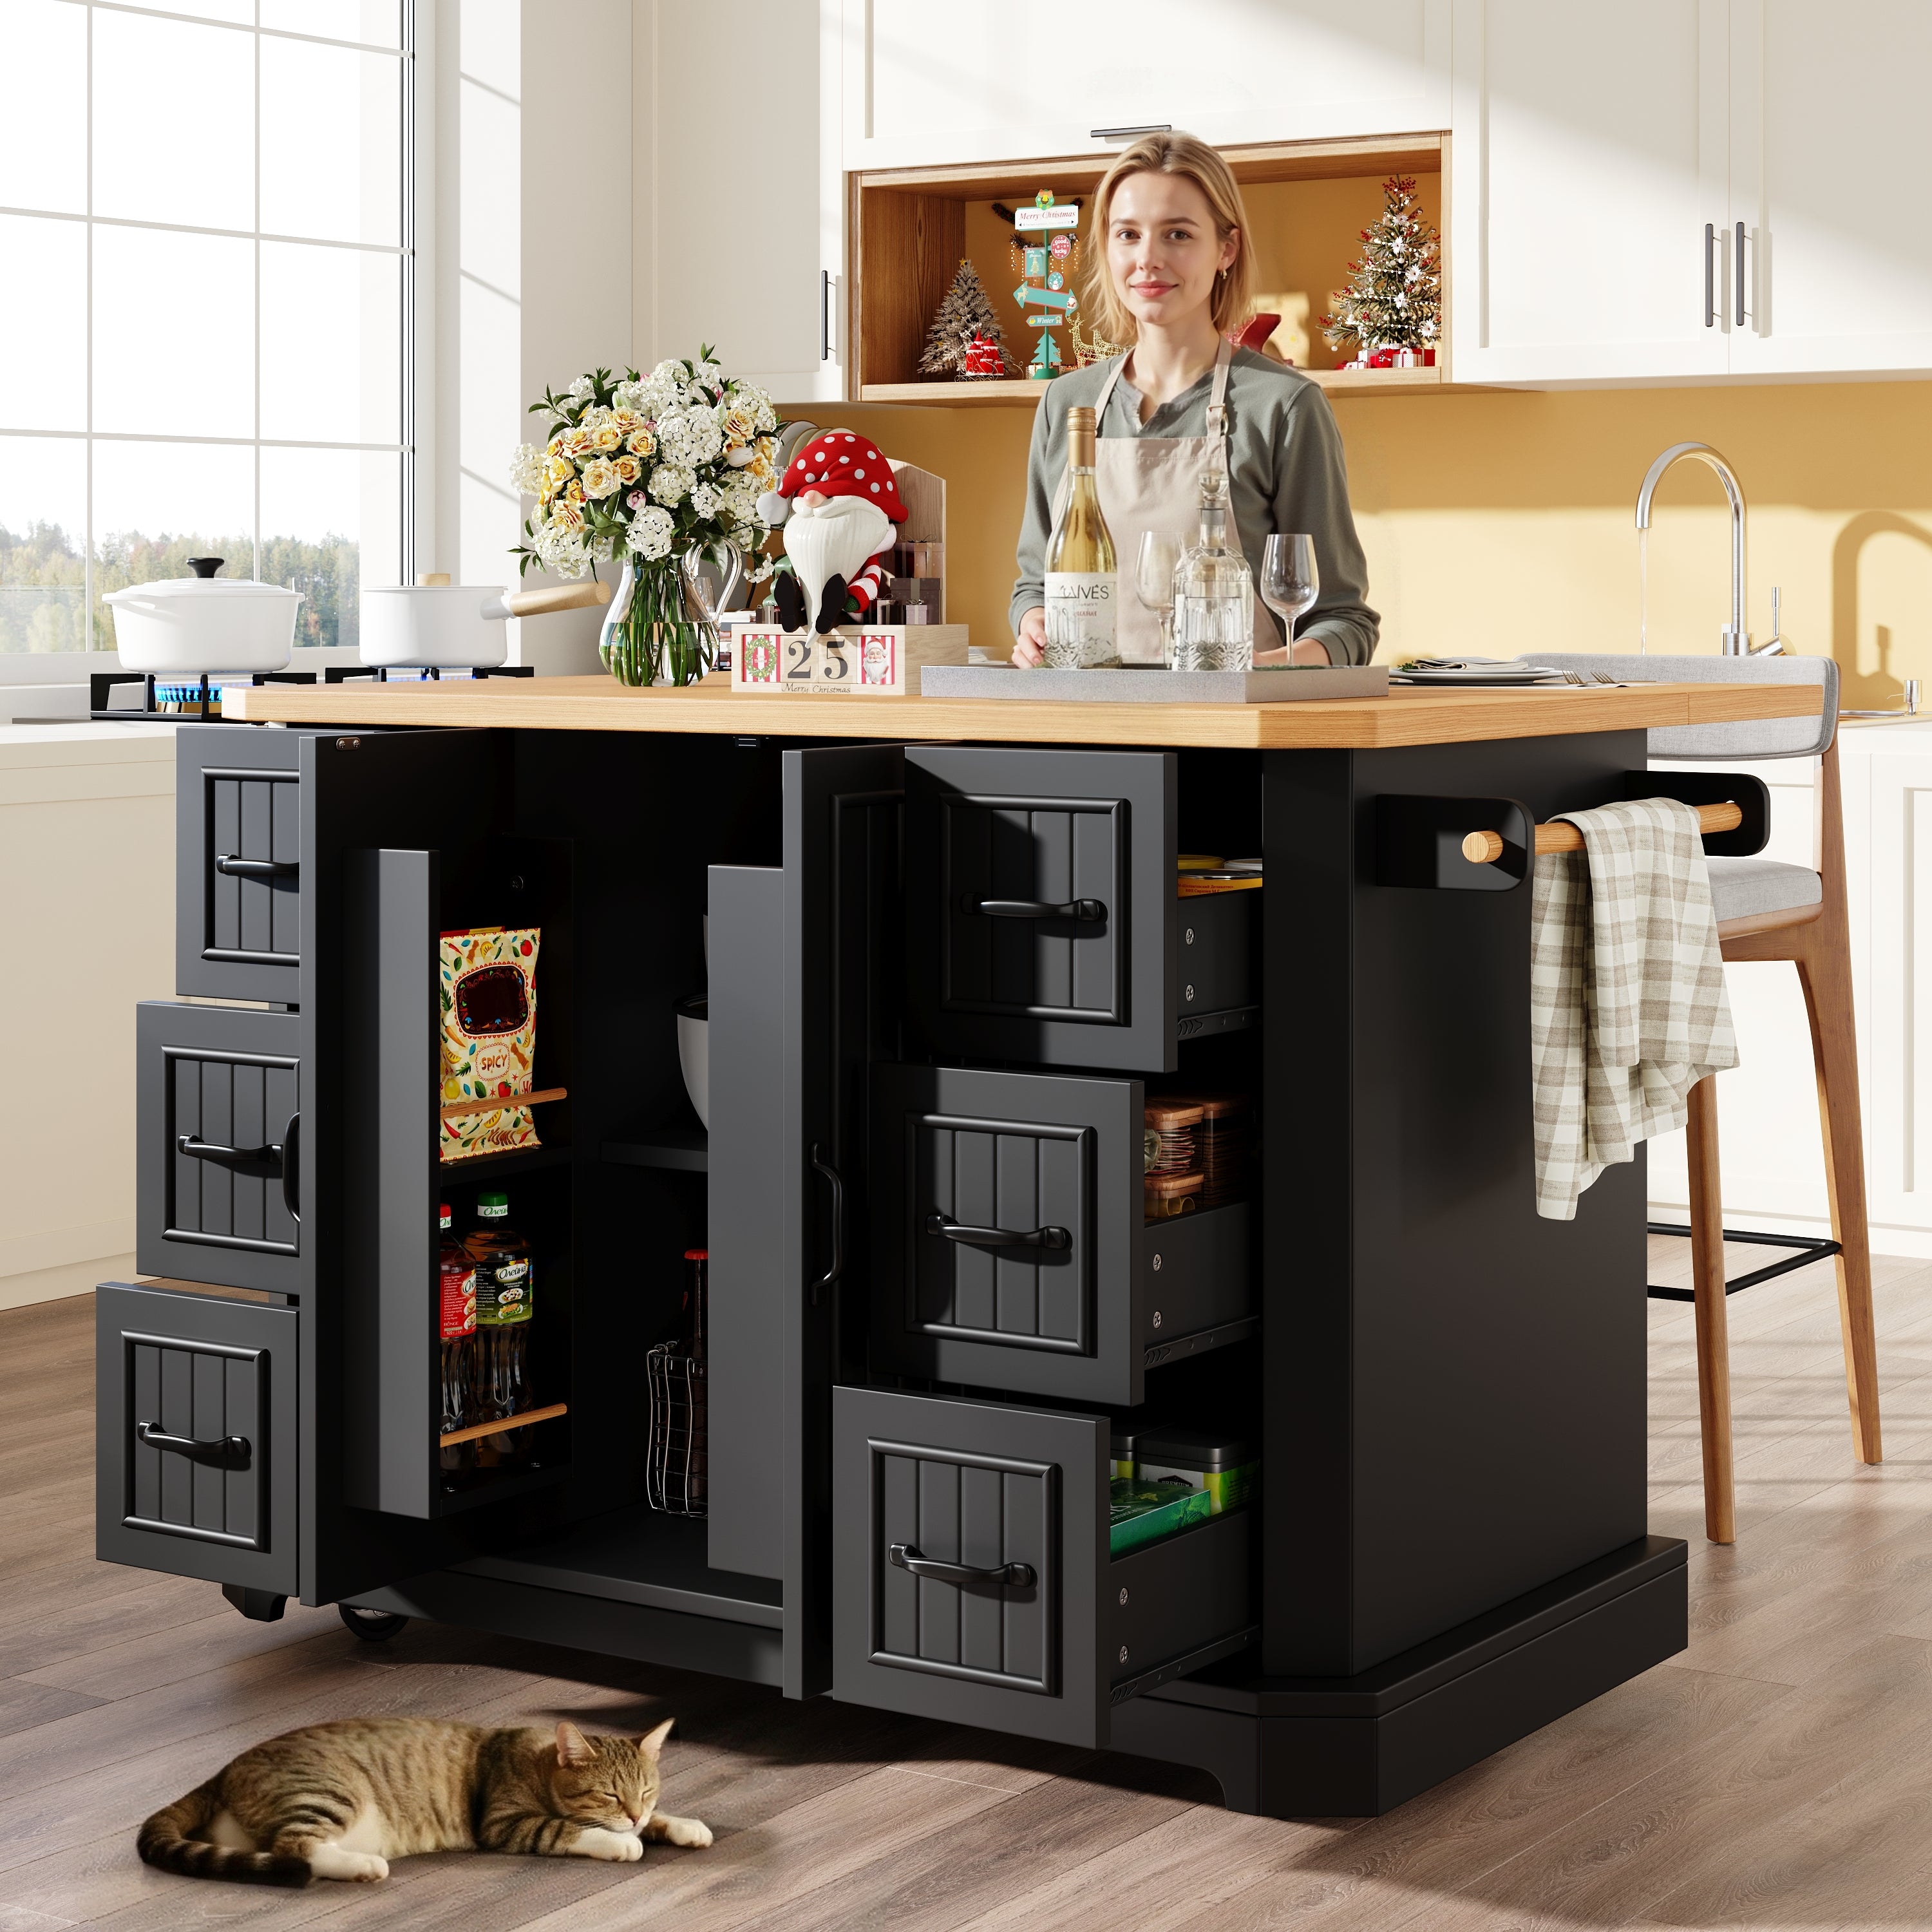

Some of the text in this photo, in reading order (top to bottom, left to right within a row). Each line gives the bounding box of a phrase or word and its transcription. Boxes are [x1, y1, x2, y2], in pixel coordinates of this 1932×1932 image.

[1019, 213, 1039, 221] Merry
[781, 683, 851, 694] Merry Christmas
[481, 1054, 507, 1071] SPICY
[499, 1265, 526, 1279] Олейна
